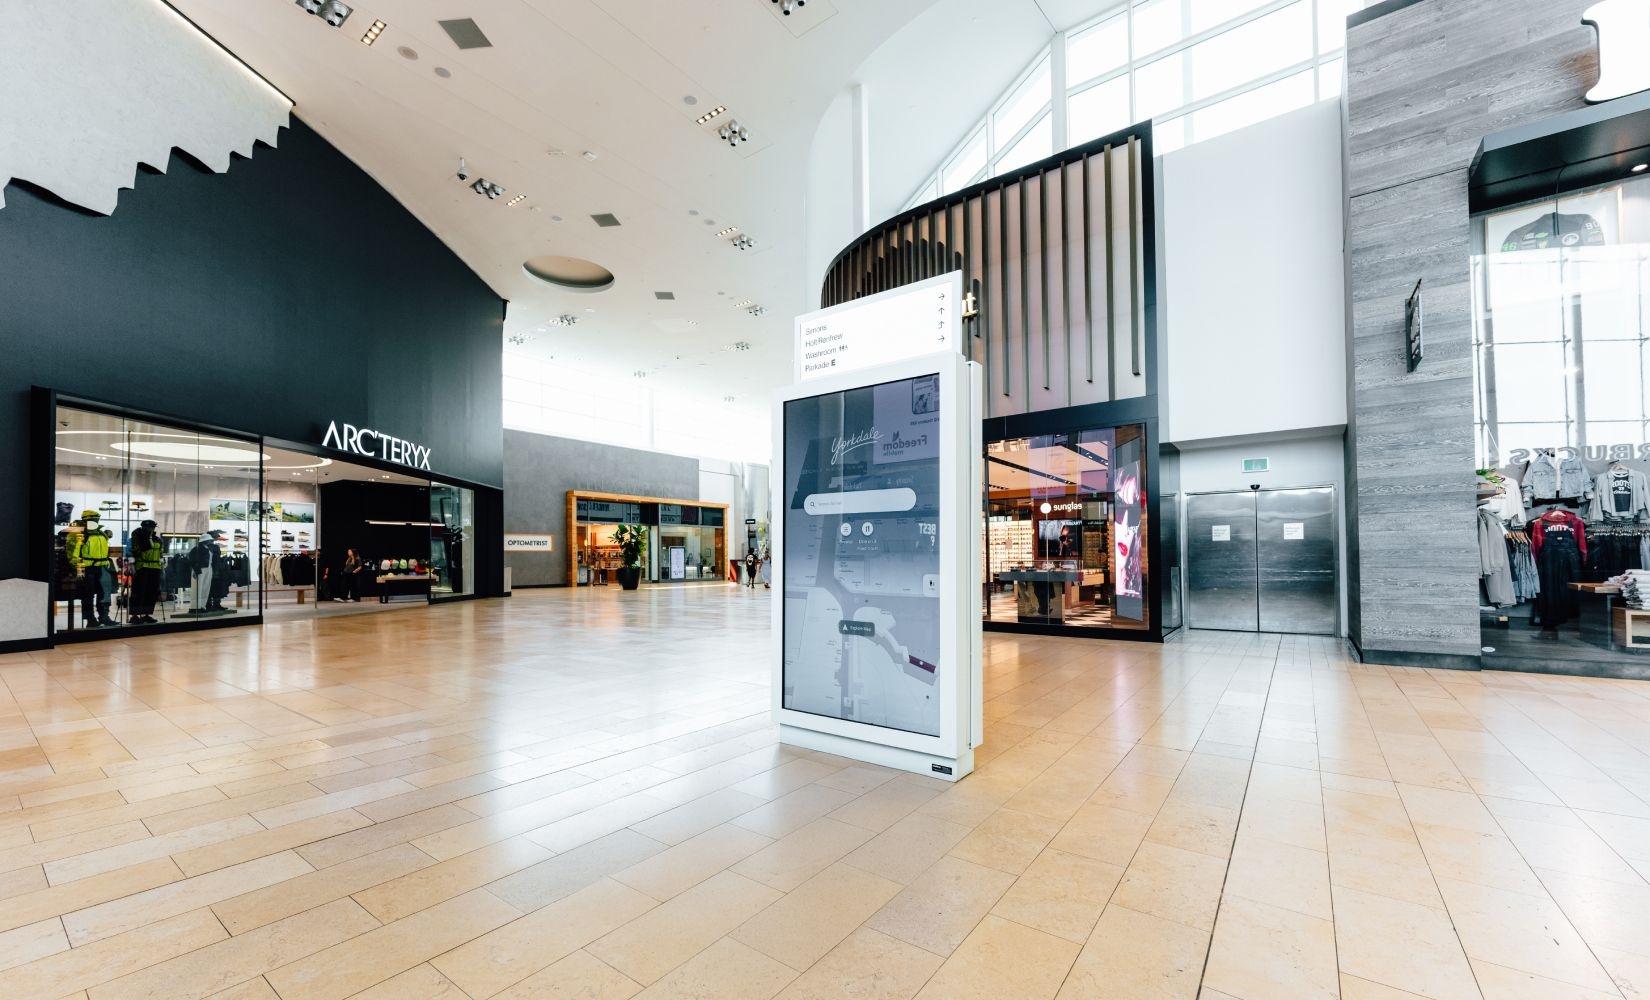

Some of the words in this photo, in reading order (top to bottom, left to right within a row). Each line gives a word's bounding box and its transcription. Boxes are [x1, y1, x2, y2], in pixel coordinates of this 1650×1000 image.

[806, 325, 828, 336] Simons
[818, 333, 844, 345] Renfrew
[806, 348, 837, 360] Washroom
[805, 361, 830, 372] Parkade
[831, 359, 837, 367] E
[321, 420, 431, 471] ARC'TERYX
[830, 426, 885, 465] Yorkdale
